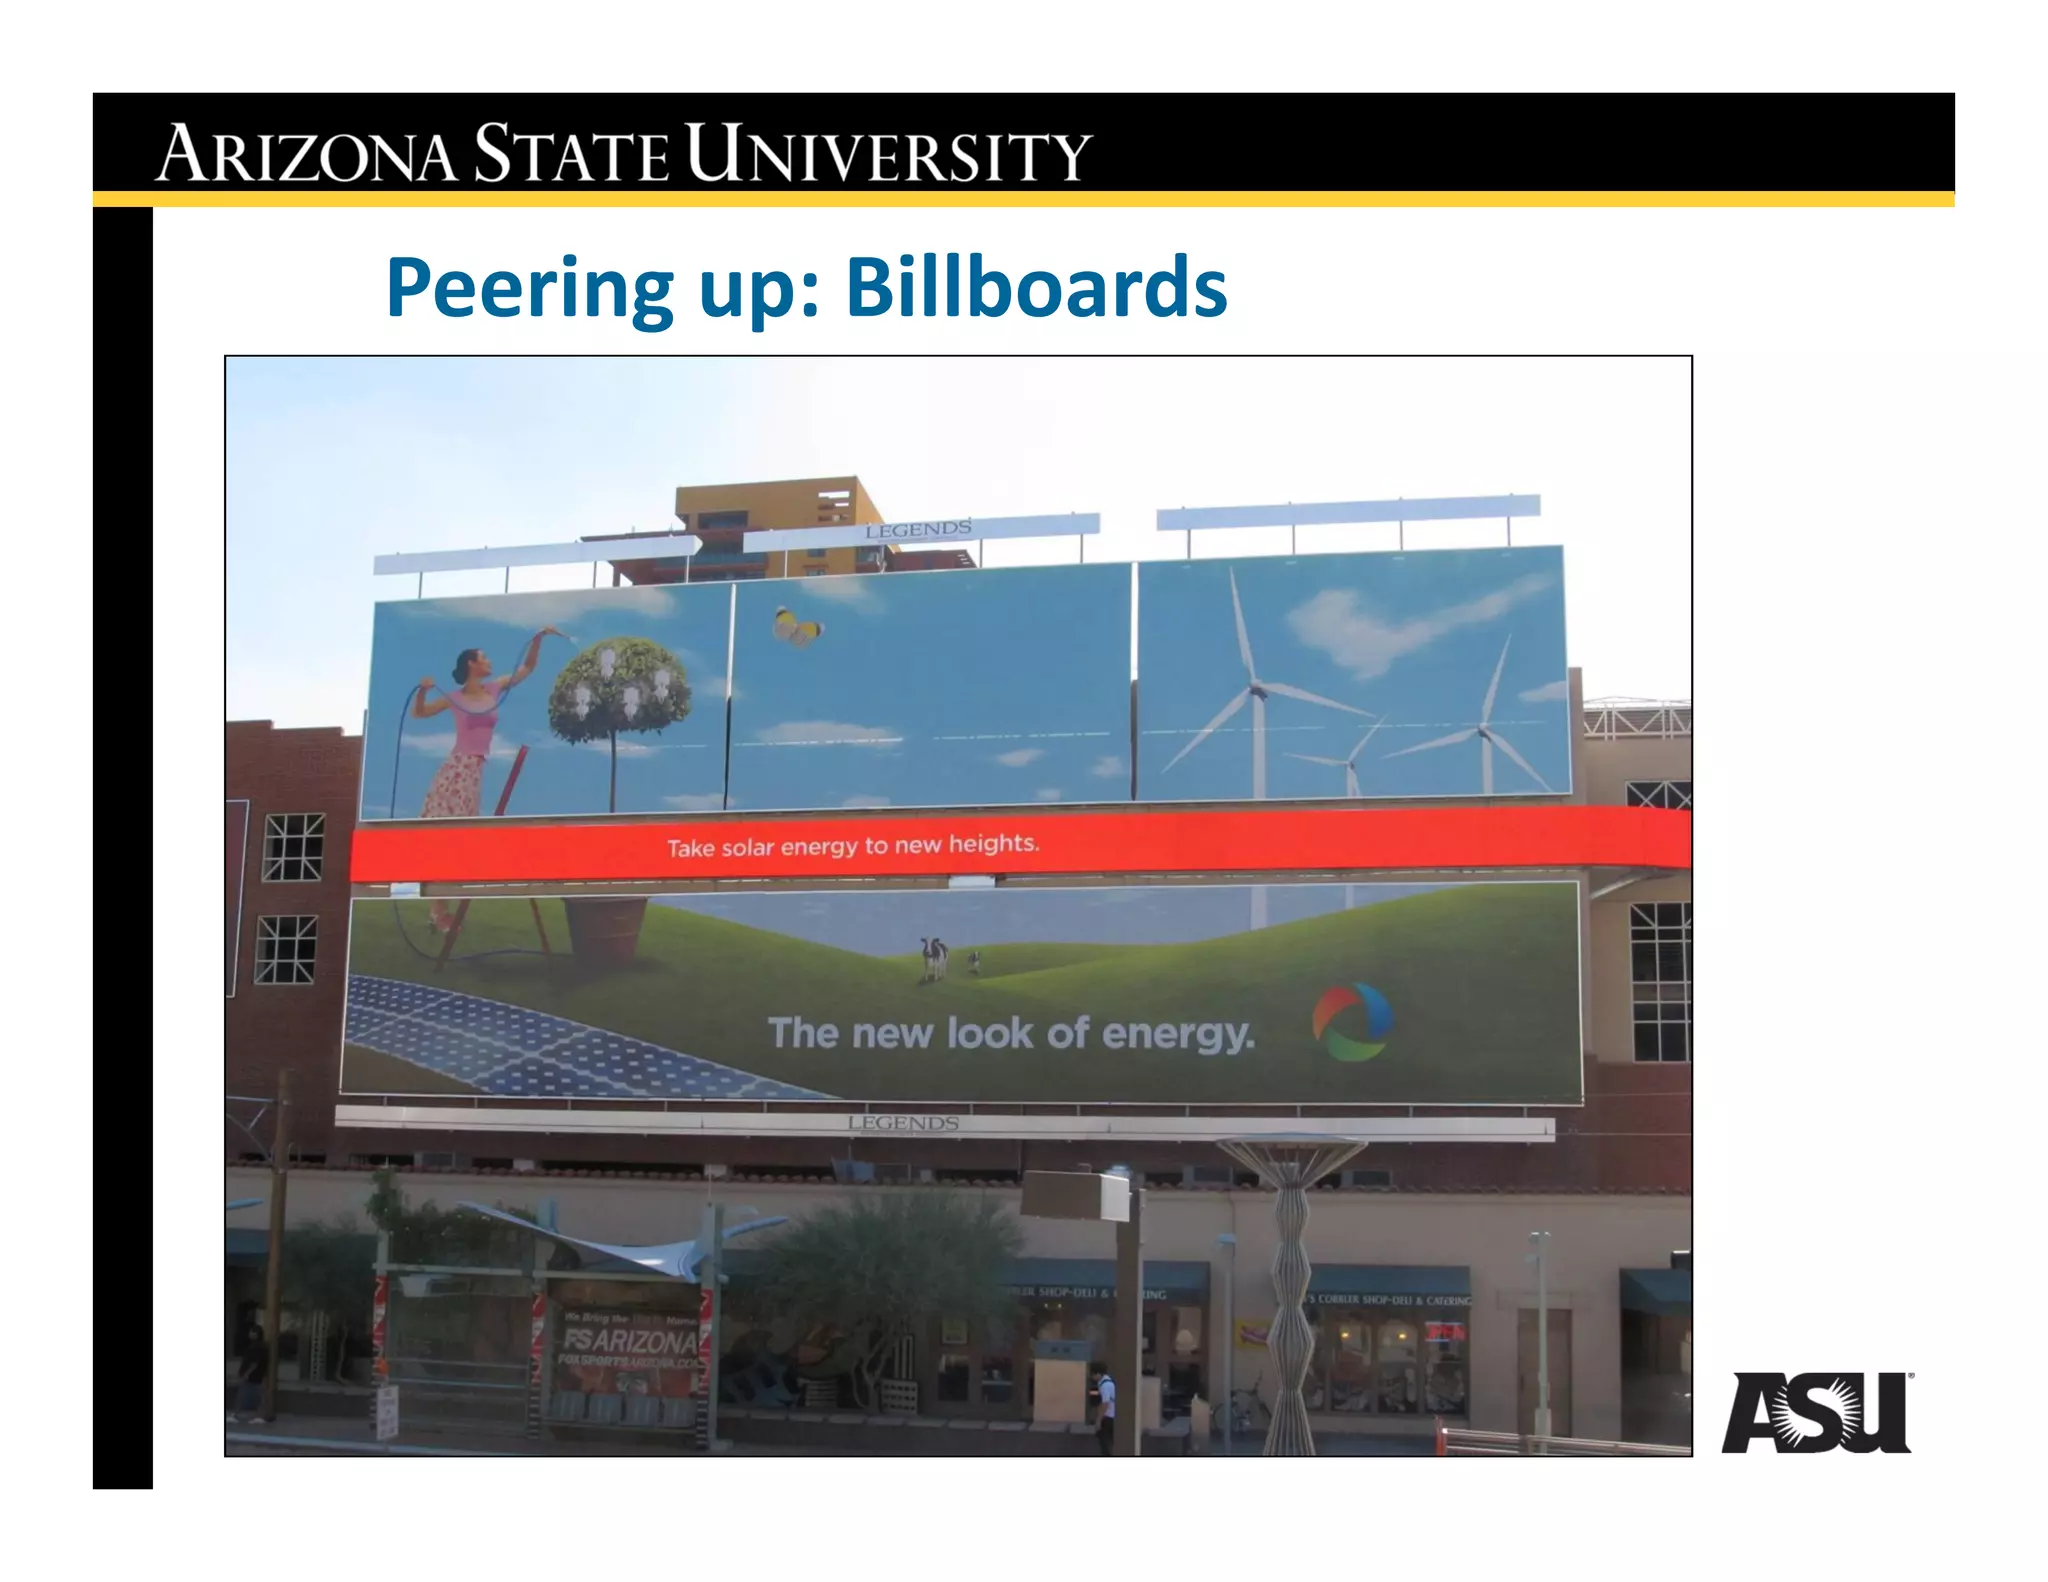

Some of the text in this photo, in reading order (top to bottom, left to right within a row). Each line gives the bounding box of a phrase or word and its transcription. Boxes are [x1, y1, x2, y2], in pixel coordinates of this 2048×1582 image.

[865, 519, 973, 540] LEGENDS
[667, 833, 1041, 860] Take solar energy to new heights.
[767, 1014, 1257, 1056] The new look of energy.
[848, 1114, 961, 1132] LEGENDS
[1100, 1290, 1109, 1299] &
[1318, 1294, 1360, 1304] COBBLER
[1415, 1296, 1424, 1306] &
[1427, 1296, 1473, 1306] CATERING
